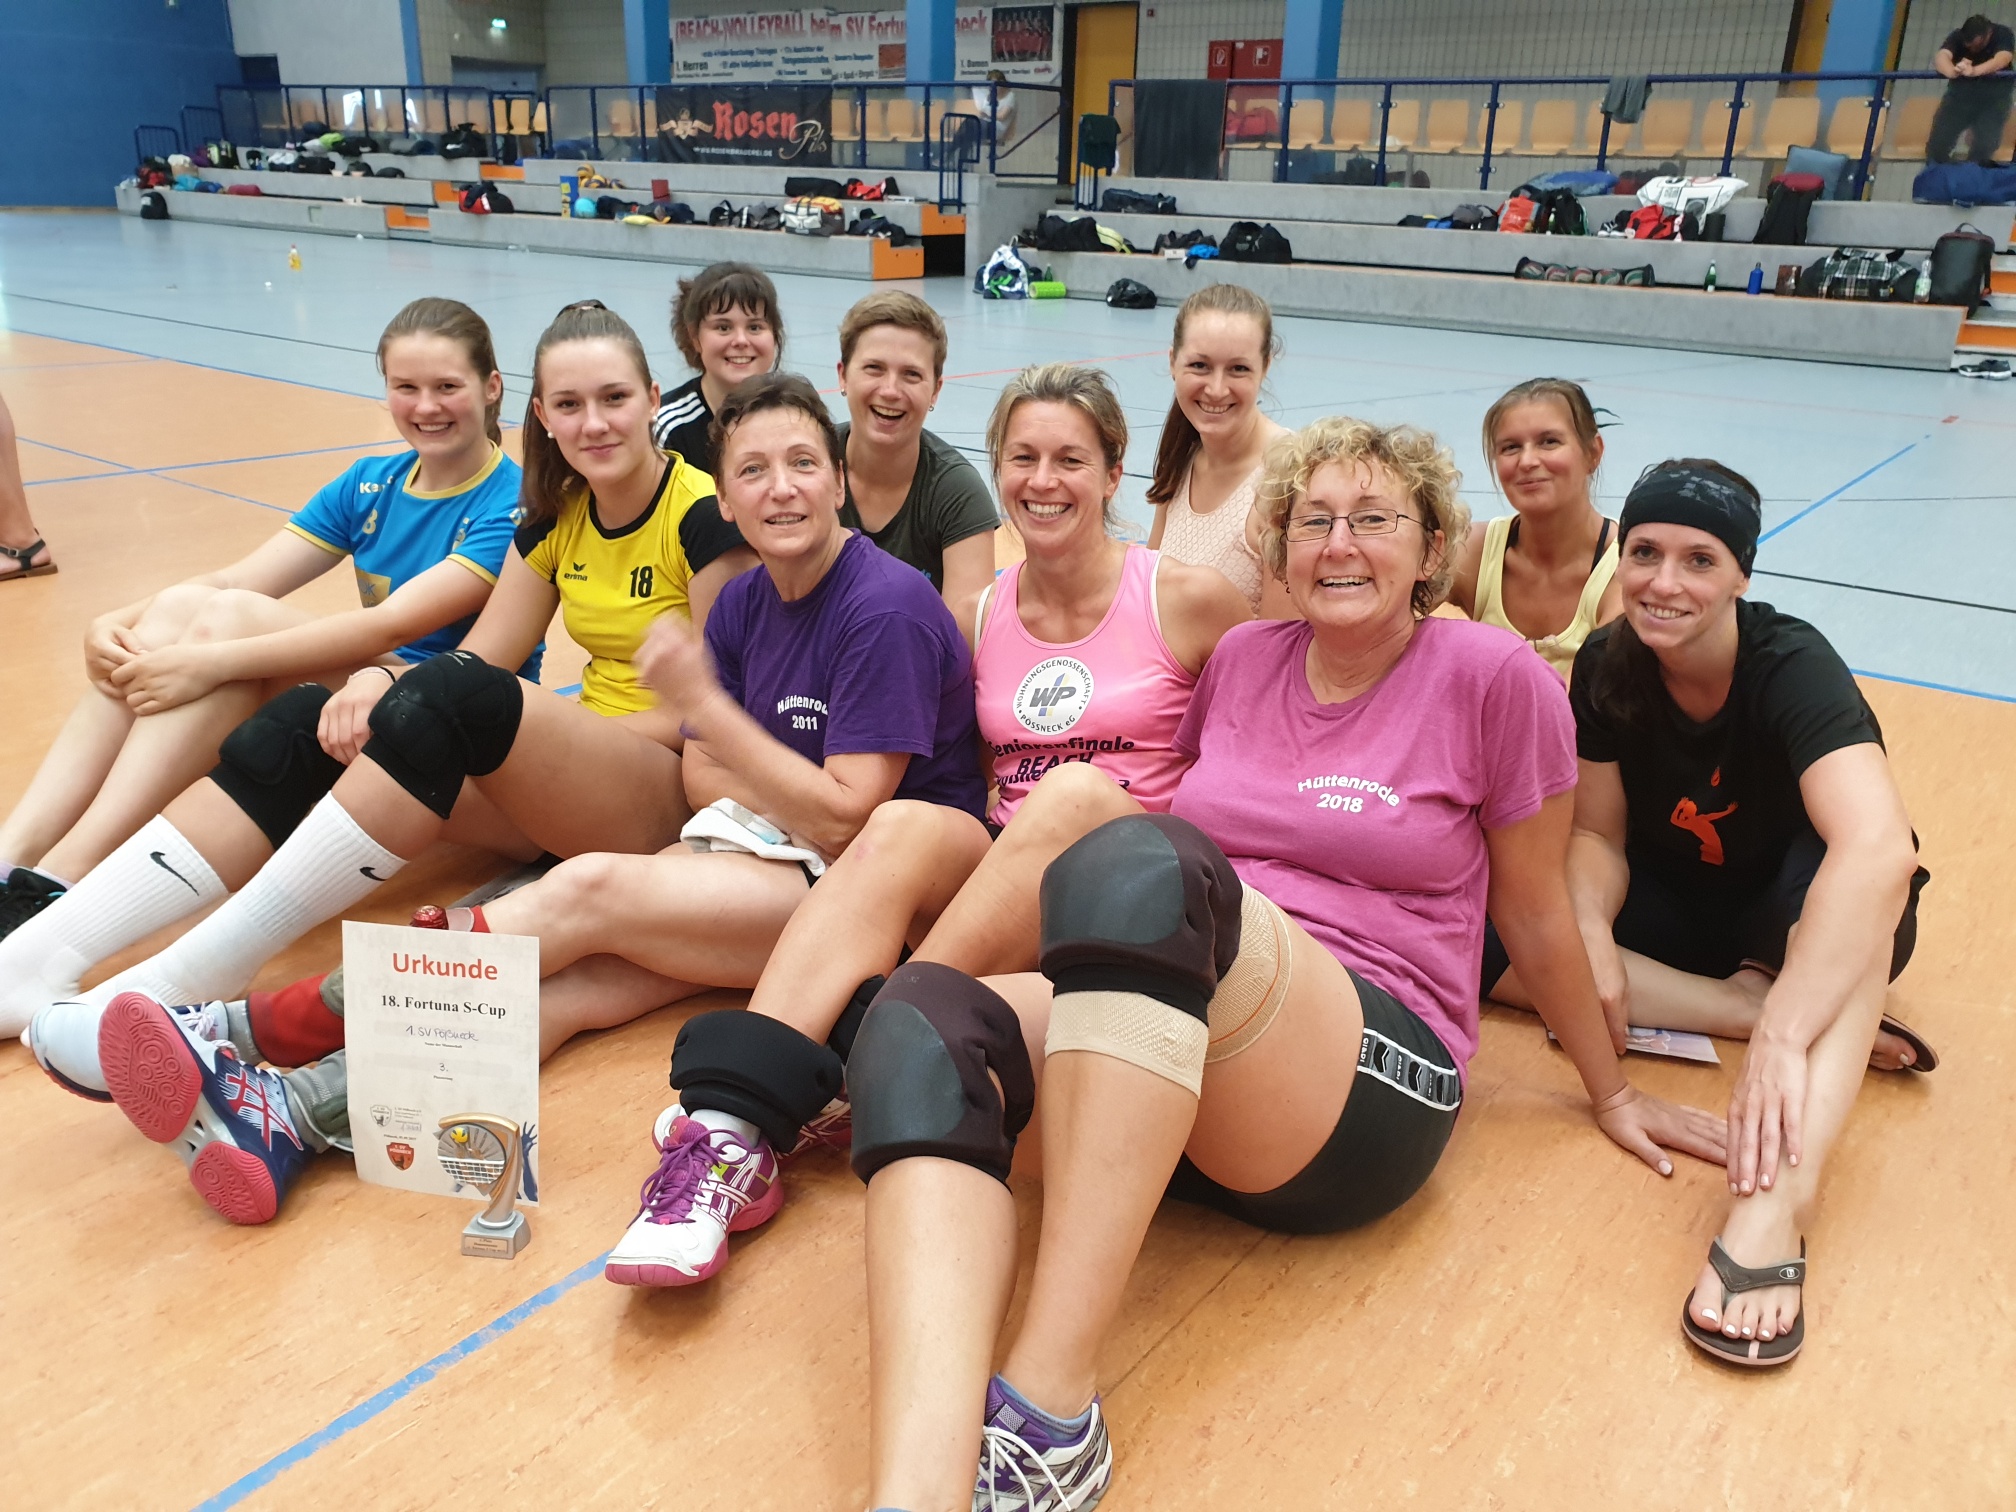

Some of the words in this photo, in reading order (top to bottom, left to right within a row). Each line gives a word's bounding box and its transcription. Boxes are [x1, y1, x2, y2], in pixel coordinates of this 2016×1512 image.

[810, 12, 842, 37] beim
[846, 16, 864, 35] SV
[869, 15, 907, 35] Fortu
[956, 9, 988, 34] neck
[683, 61, 709, 71] Herren
[712, 100, 798, 142] Rosen
[779, 119, 828, 160] Pils
[564, 572, 588, 582] erima
[630, 565, 654, 598] 18
[1016, 659, 1091, 709] WOHNUNGSGENOSSENSCHAFT
[1029, 686, 1077, 708] WP
[791, 714, 818, 731] 2011
[1020, 714, 1064, 733] PÖSSNECK
[1065, 714, 1076, 726] eG
[1016, 751, 1095, 777] BEACH
[1297, 774, 1401, 808] Hüttenrode
[1316, 793, 1364, 813] 2018
[392, 952, 498, 981] Urkunde
[381, 994, 400, 1008] 18.
[405, 996, 460, 1013] Fortuna
[463, 1000, 507, 1020] S-Cup
[405, 1025, 415, 1036] 1.
[418, 1026, 431, 1037] SV
[439, 1062, 449, 1072] 3.
